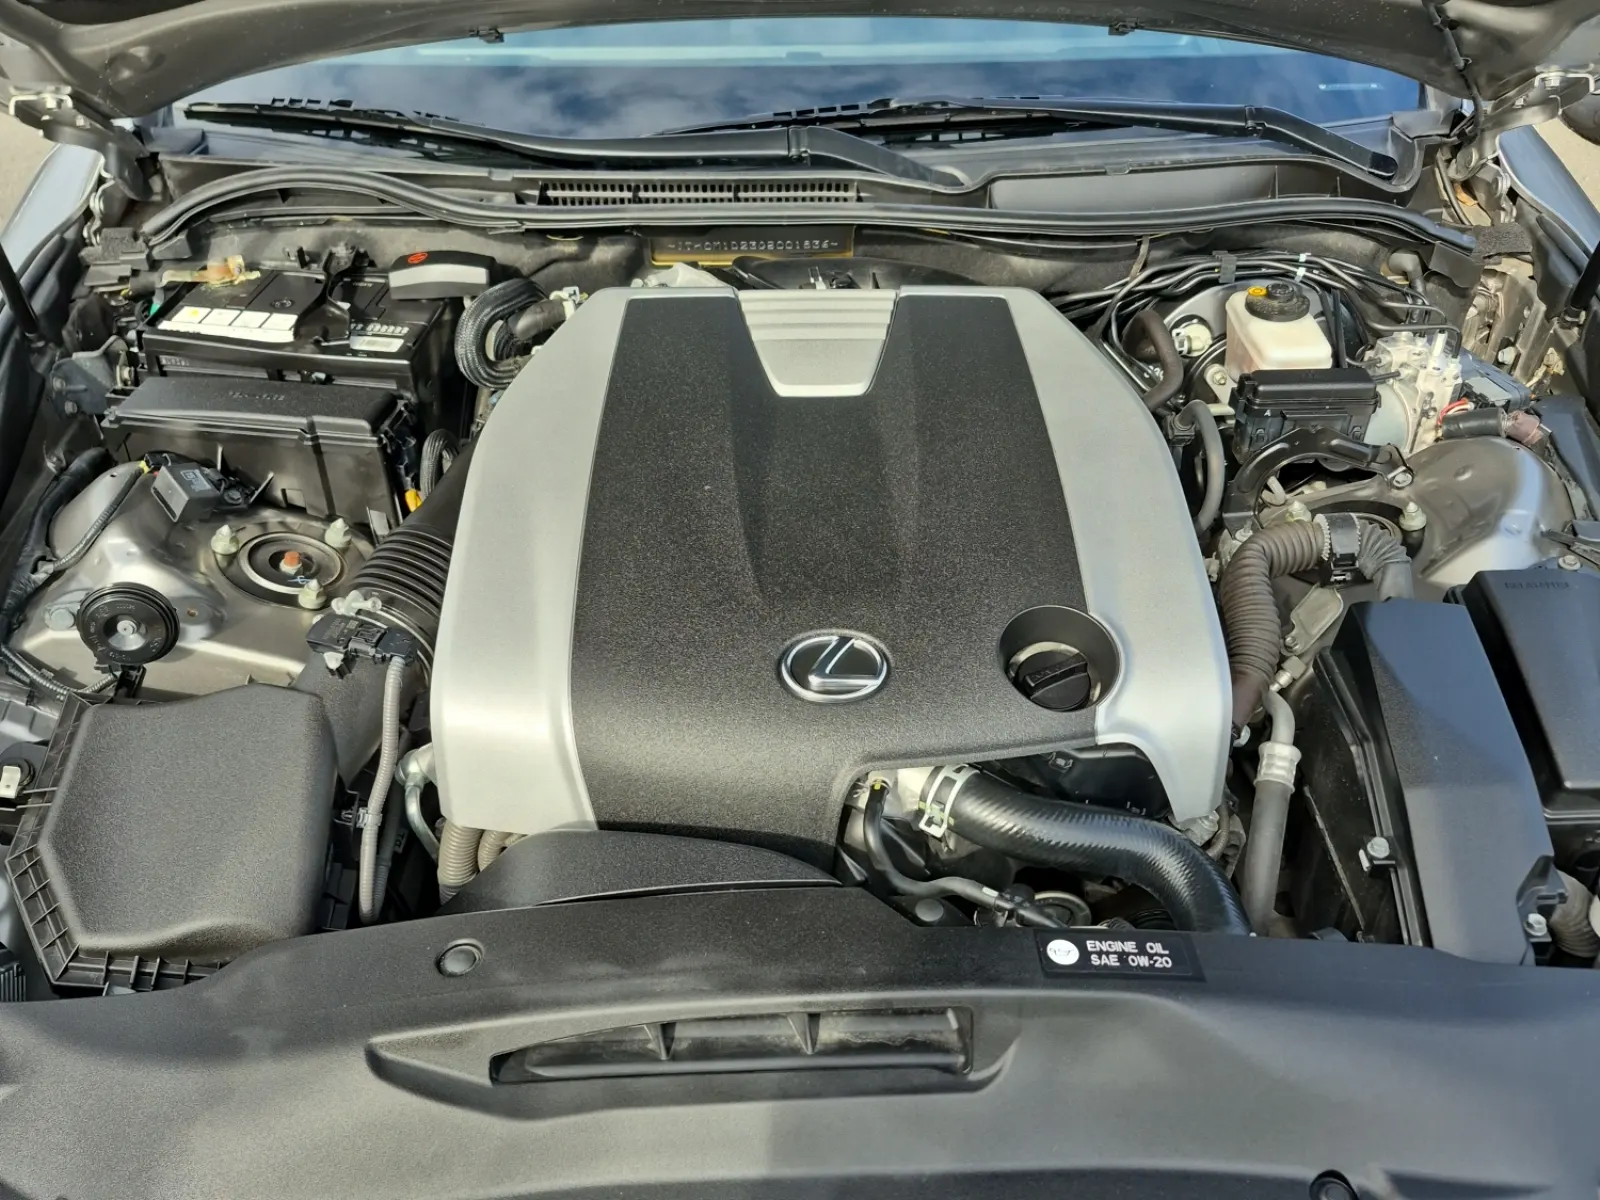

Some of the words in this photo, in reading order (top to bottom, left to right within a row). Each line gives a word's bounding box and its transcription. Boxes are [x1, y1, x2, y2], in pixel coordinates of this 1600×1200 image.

[1086, 940, 1138, 953] ENGINE
[1145, 942, 1169, 954] OIL
[1090, 954, 1120, 966] SAE
[1128, 955, 1172, 968] 0W-20
